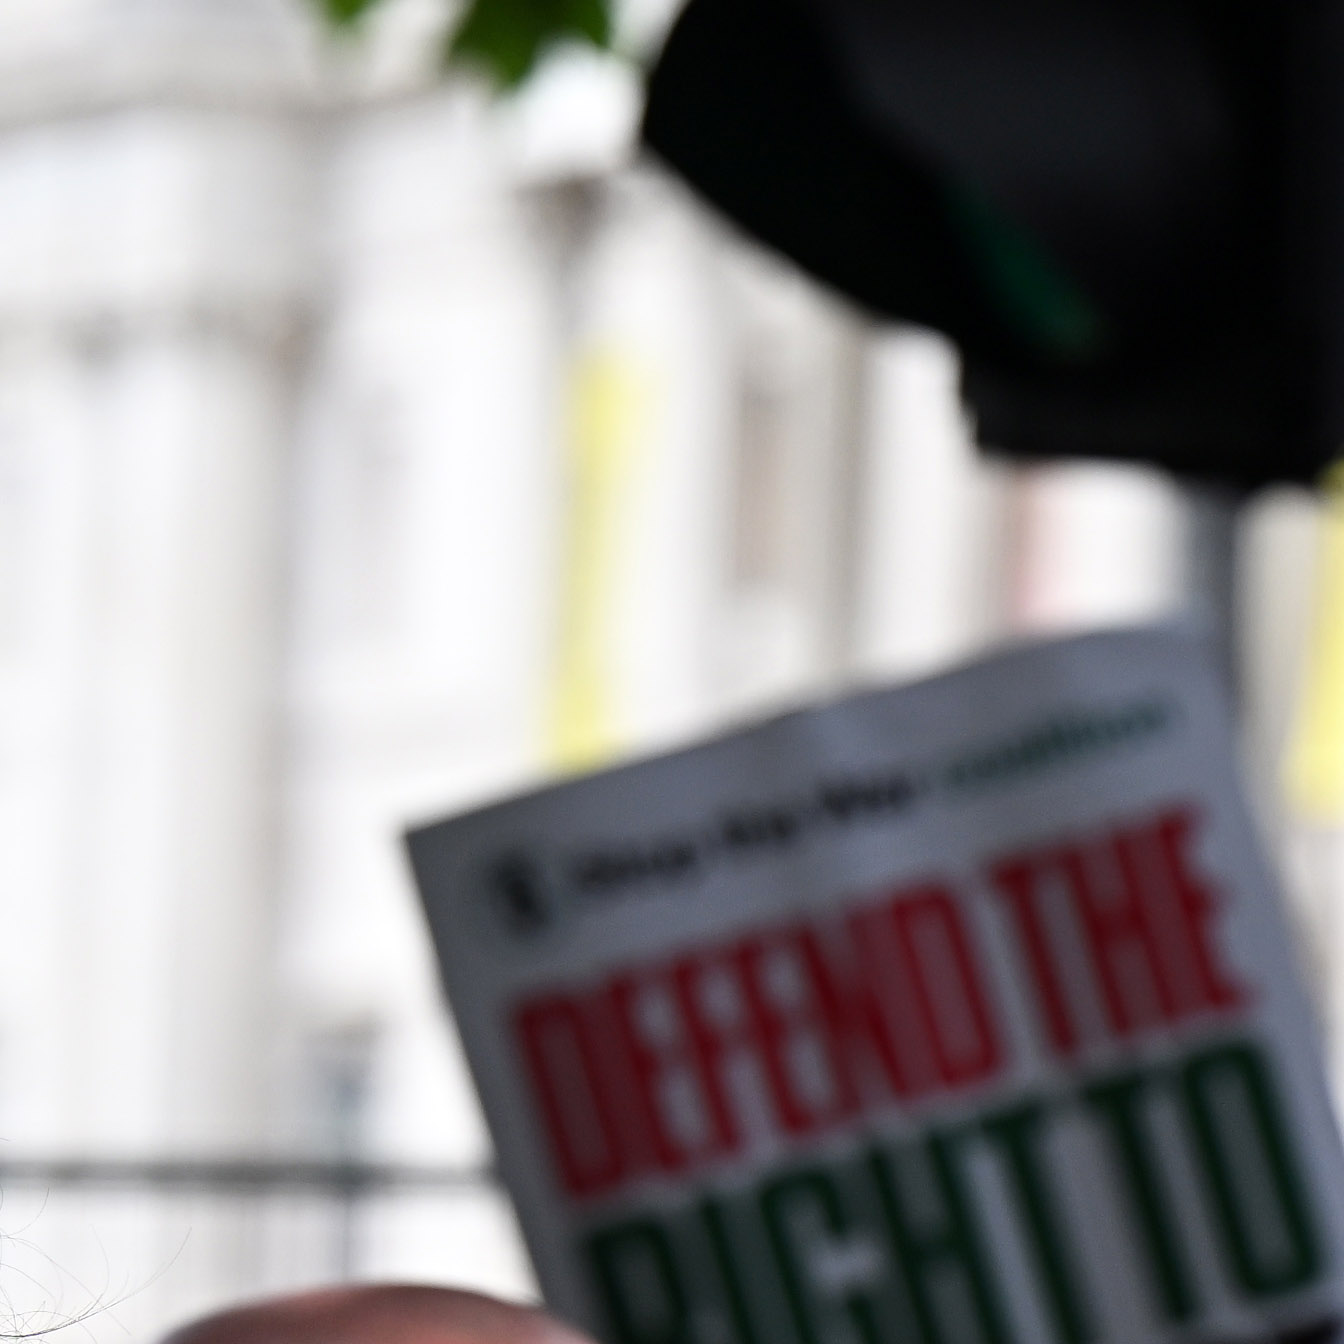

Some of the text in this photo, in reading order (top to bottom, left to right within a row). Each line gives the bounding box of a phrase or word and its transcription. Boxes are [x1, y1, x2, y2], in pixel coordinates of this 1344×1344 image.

[508, 805, 1255, 1202] DEFEND THE
[1074, 1038, 1324, 1324] TO
